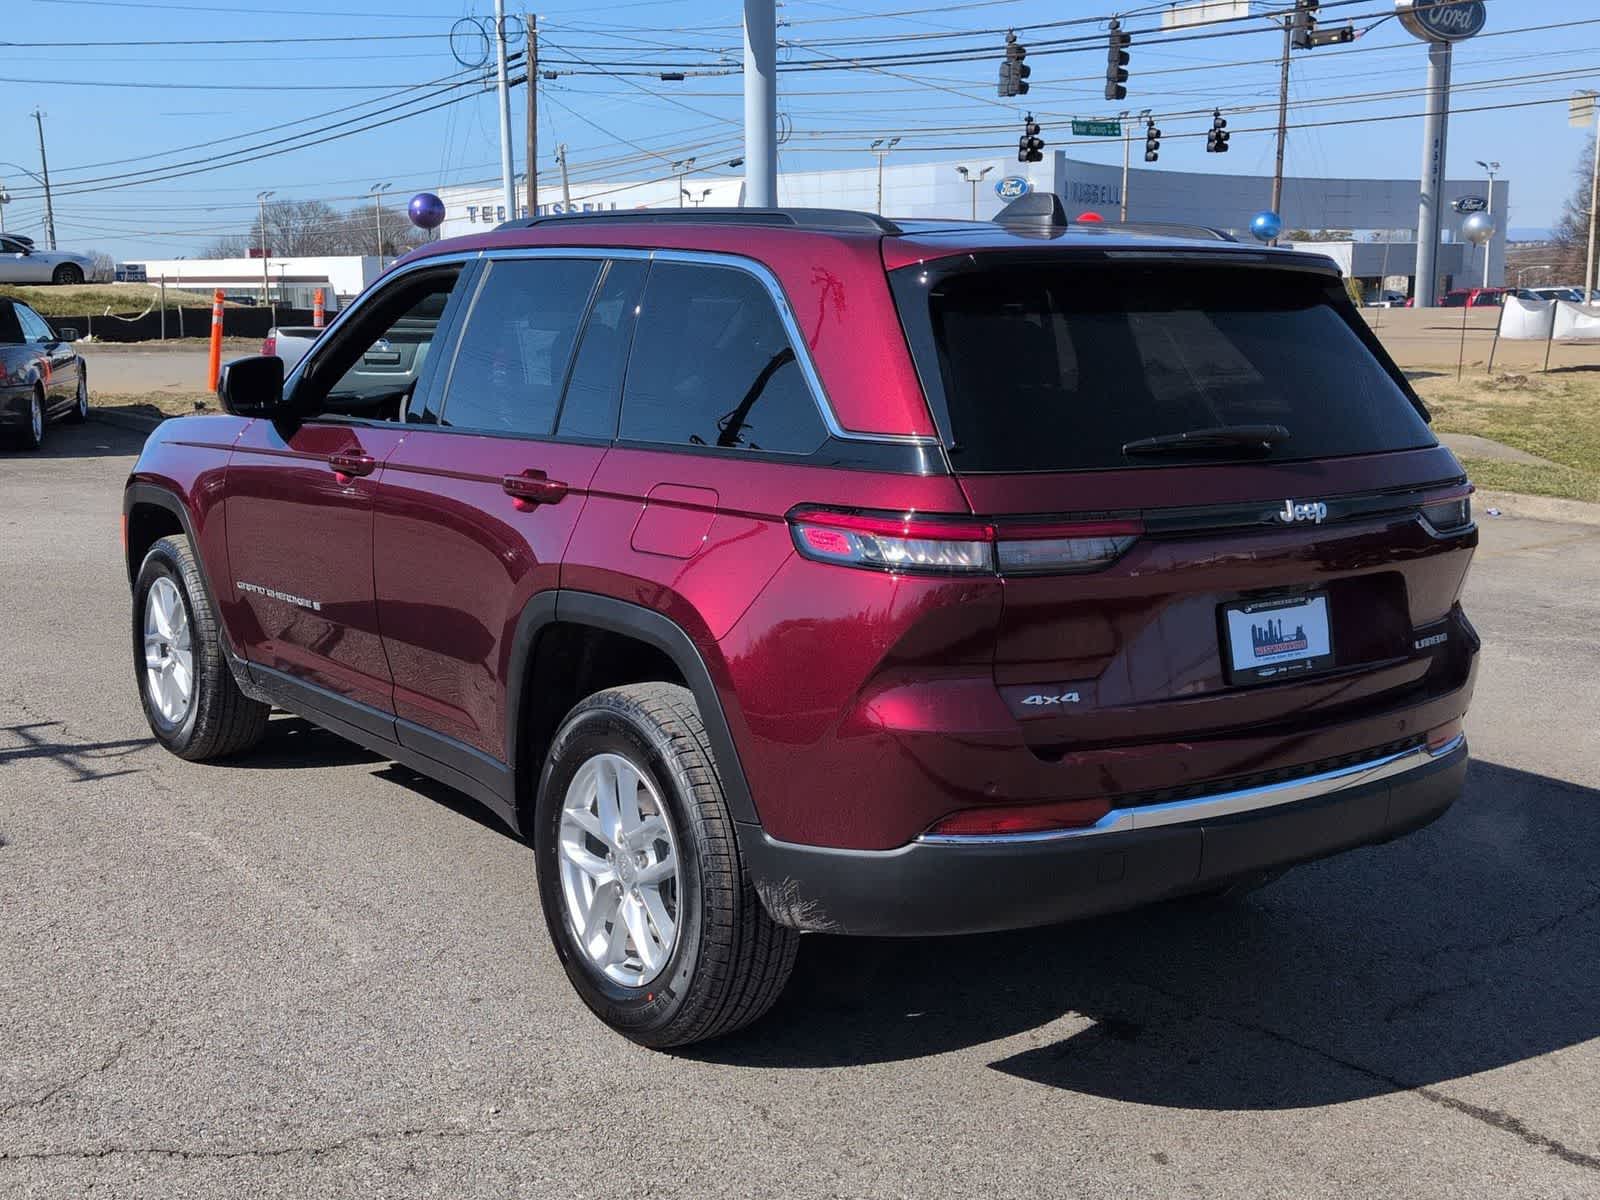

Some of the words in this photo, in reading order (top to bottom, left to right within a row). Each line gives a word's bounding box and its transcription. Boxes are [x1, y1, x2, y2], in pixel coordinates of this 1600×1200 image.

[1428, 0, 1474, 29] Ford
[1000, 180, 1023, 196] Ford
[466, 205, 506, 223] TED
[1279, 499, 1328, 524] Jeep
[236, 582, 265, 594] GRAND
[267, 590, 312, 608] CHEROKEE
